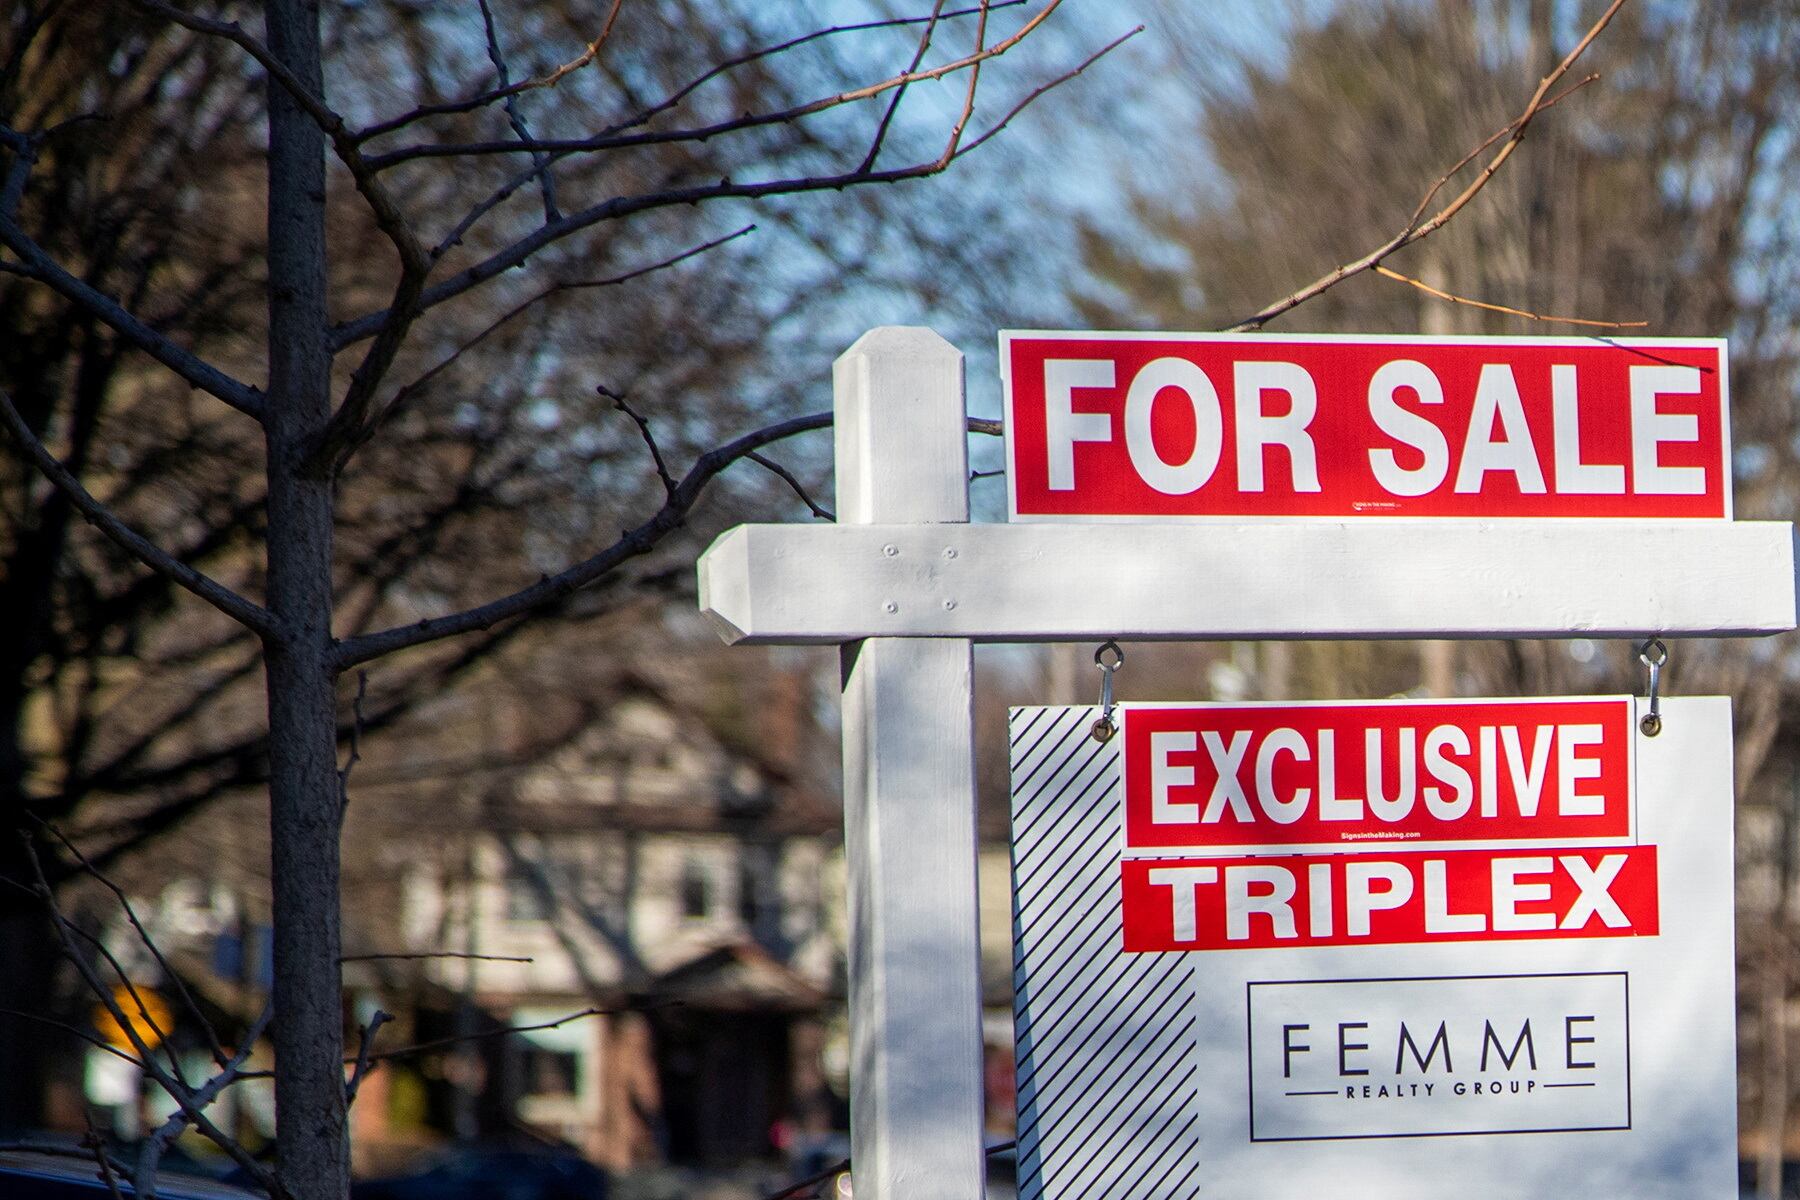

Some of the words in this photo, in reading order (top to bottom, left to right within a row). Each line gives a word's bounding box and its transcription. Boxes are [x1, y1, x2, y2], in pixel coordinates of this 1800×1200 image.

[1044, 357, 1322, 494] FOR
[1368, 360, 1707, 497] SALE
[1151, 724, 1604, 824] EXCLUSIVE
[1148, 853, 1632, 943] TRIPLEX
[1283, 1016, 1596, 1078] FEMME
[1347, 1083, 1434, 1099] REALTY
[1454, 1080, 1536, 1096] GROUP
